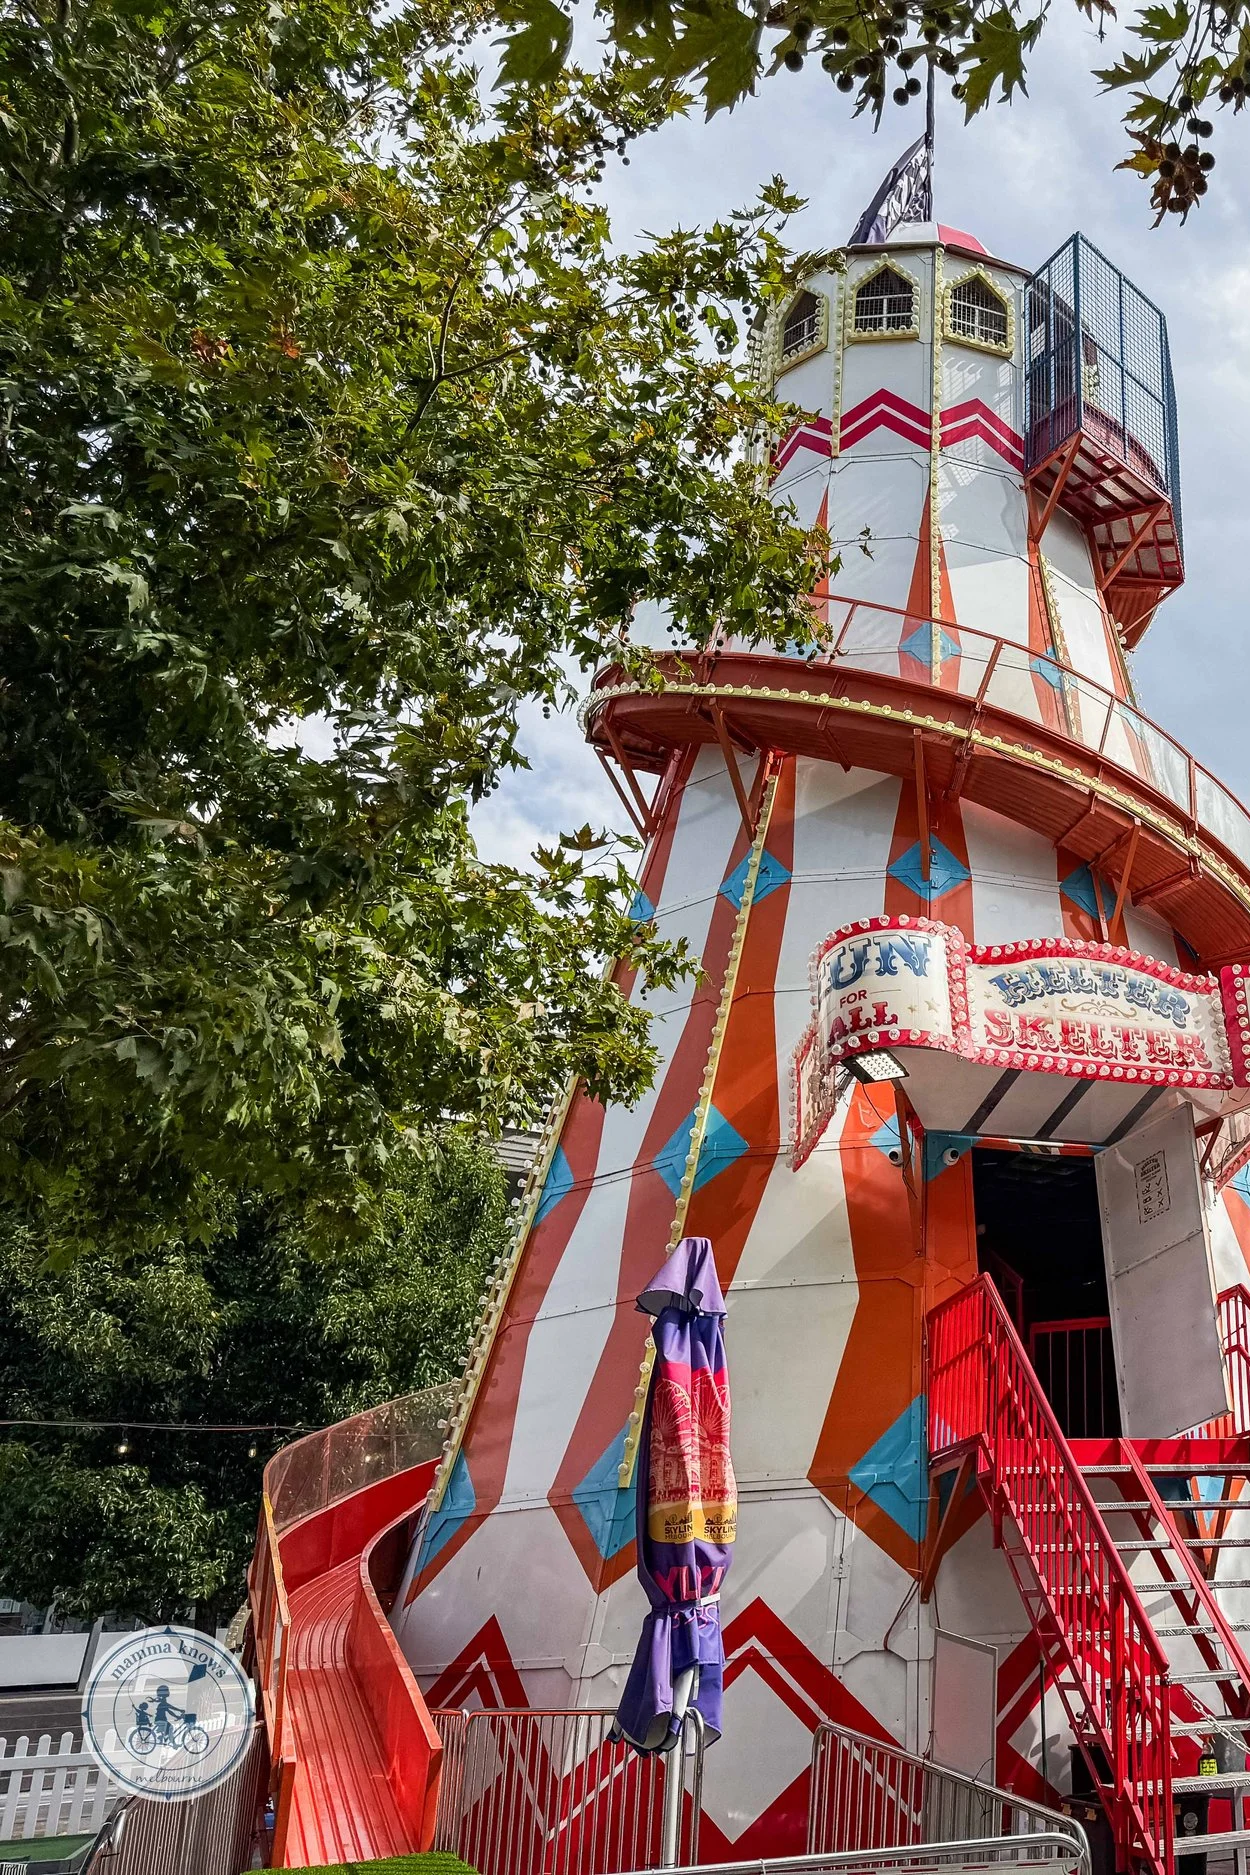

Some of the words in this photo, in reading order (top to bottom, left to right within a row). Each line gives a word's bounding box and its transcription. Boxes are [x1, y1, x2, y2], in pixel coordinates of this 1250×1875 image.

[820, 934, 932, 998] UN
[988, 959, 1192, 1028] HELTER
[827, 1001, 899, 1048] ALL
[839, 989, 868, 1009] FOR
[983, 1009, 1213, 1070] SKELTER
